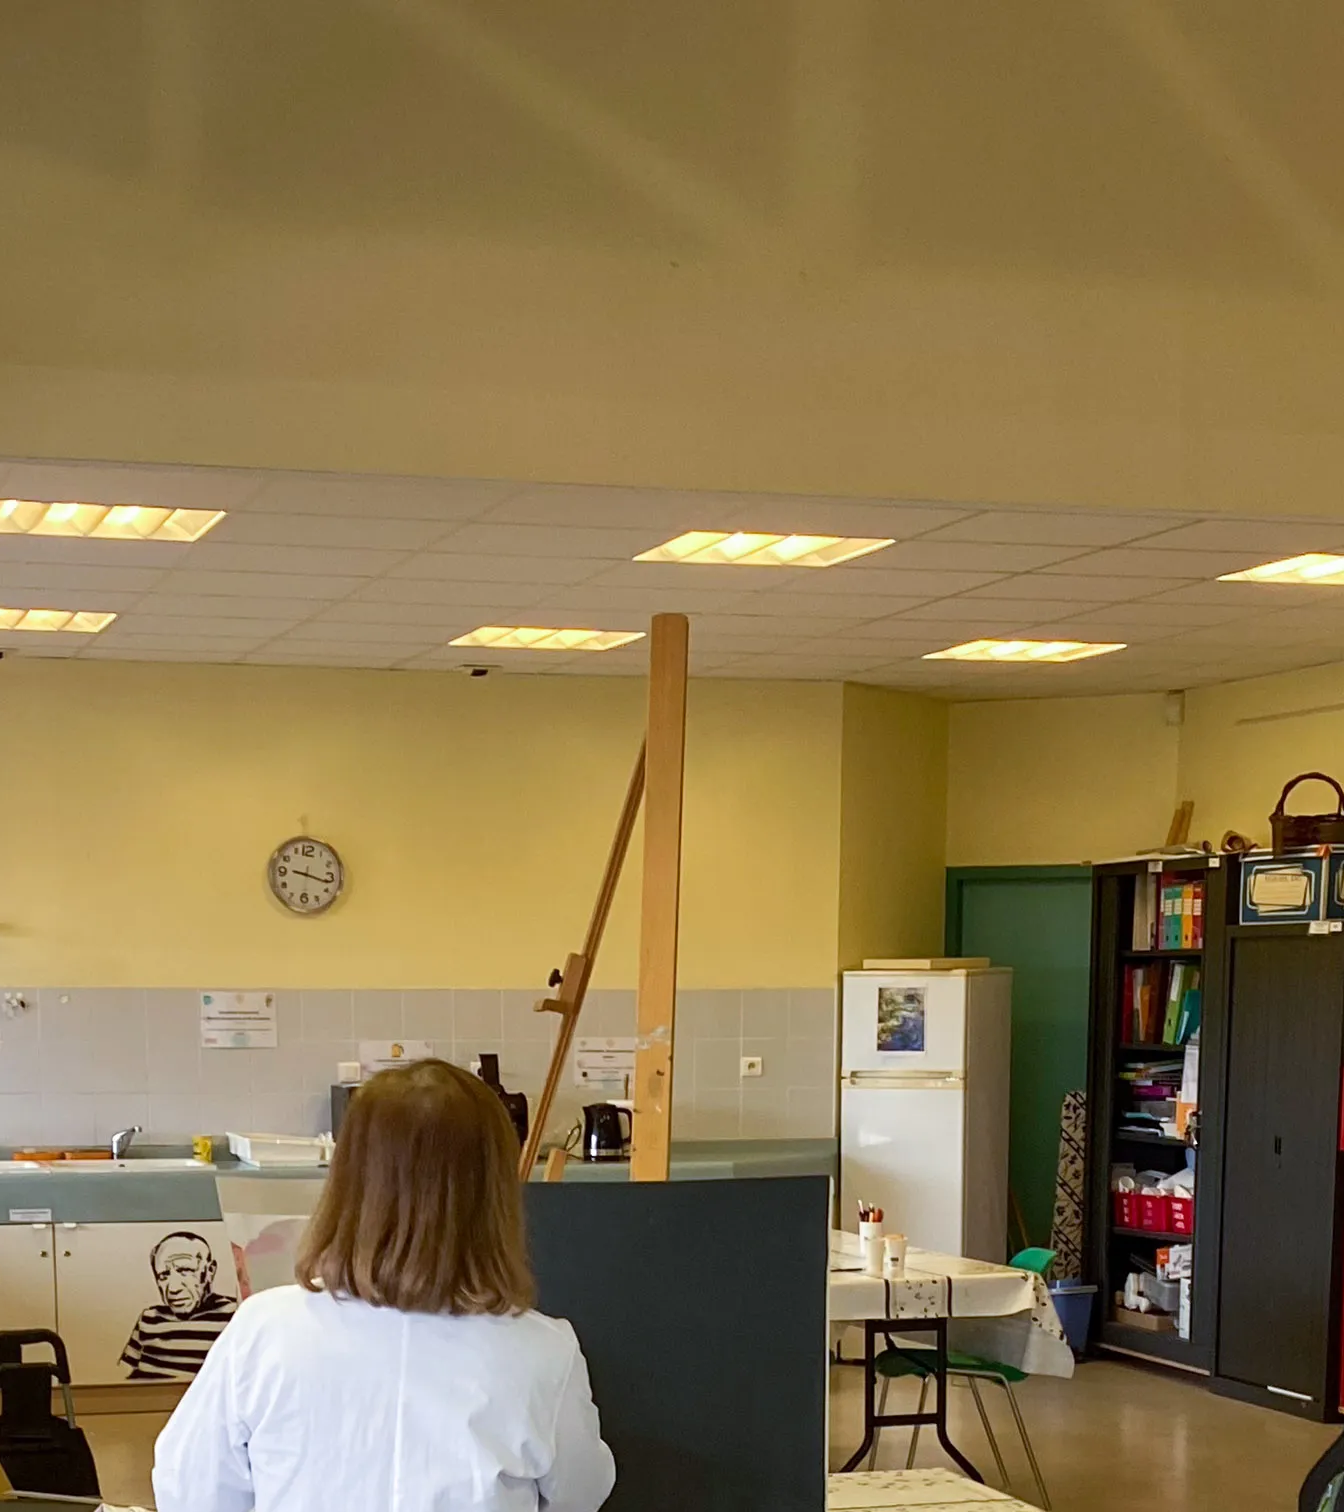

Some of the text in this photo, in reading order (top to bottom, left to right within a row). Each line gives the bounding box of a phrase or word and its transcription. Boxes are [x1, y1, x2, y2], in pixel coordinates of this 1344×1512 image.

[301, 844, 314, 857] 12
[278, 866, 287, 877] 9
[325, 871, 335, 883] 3
[299, 892, 309, 904] 6
